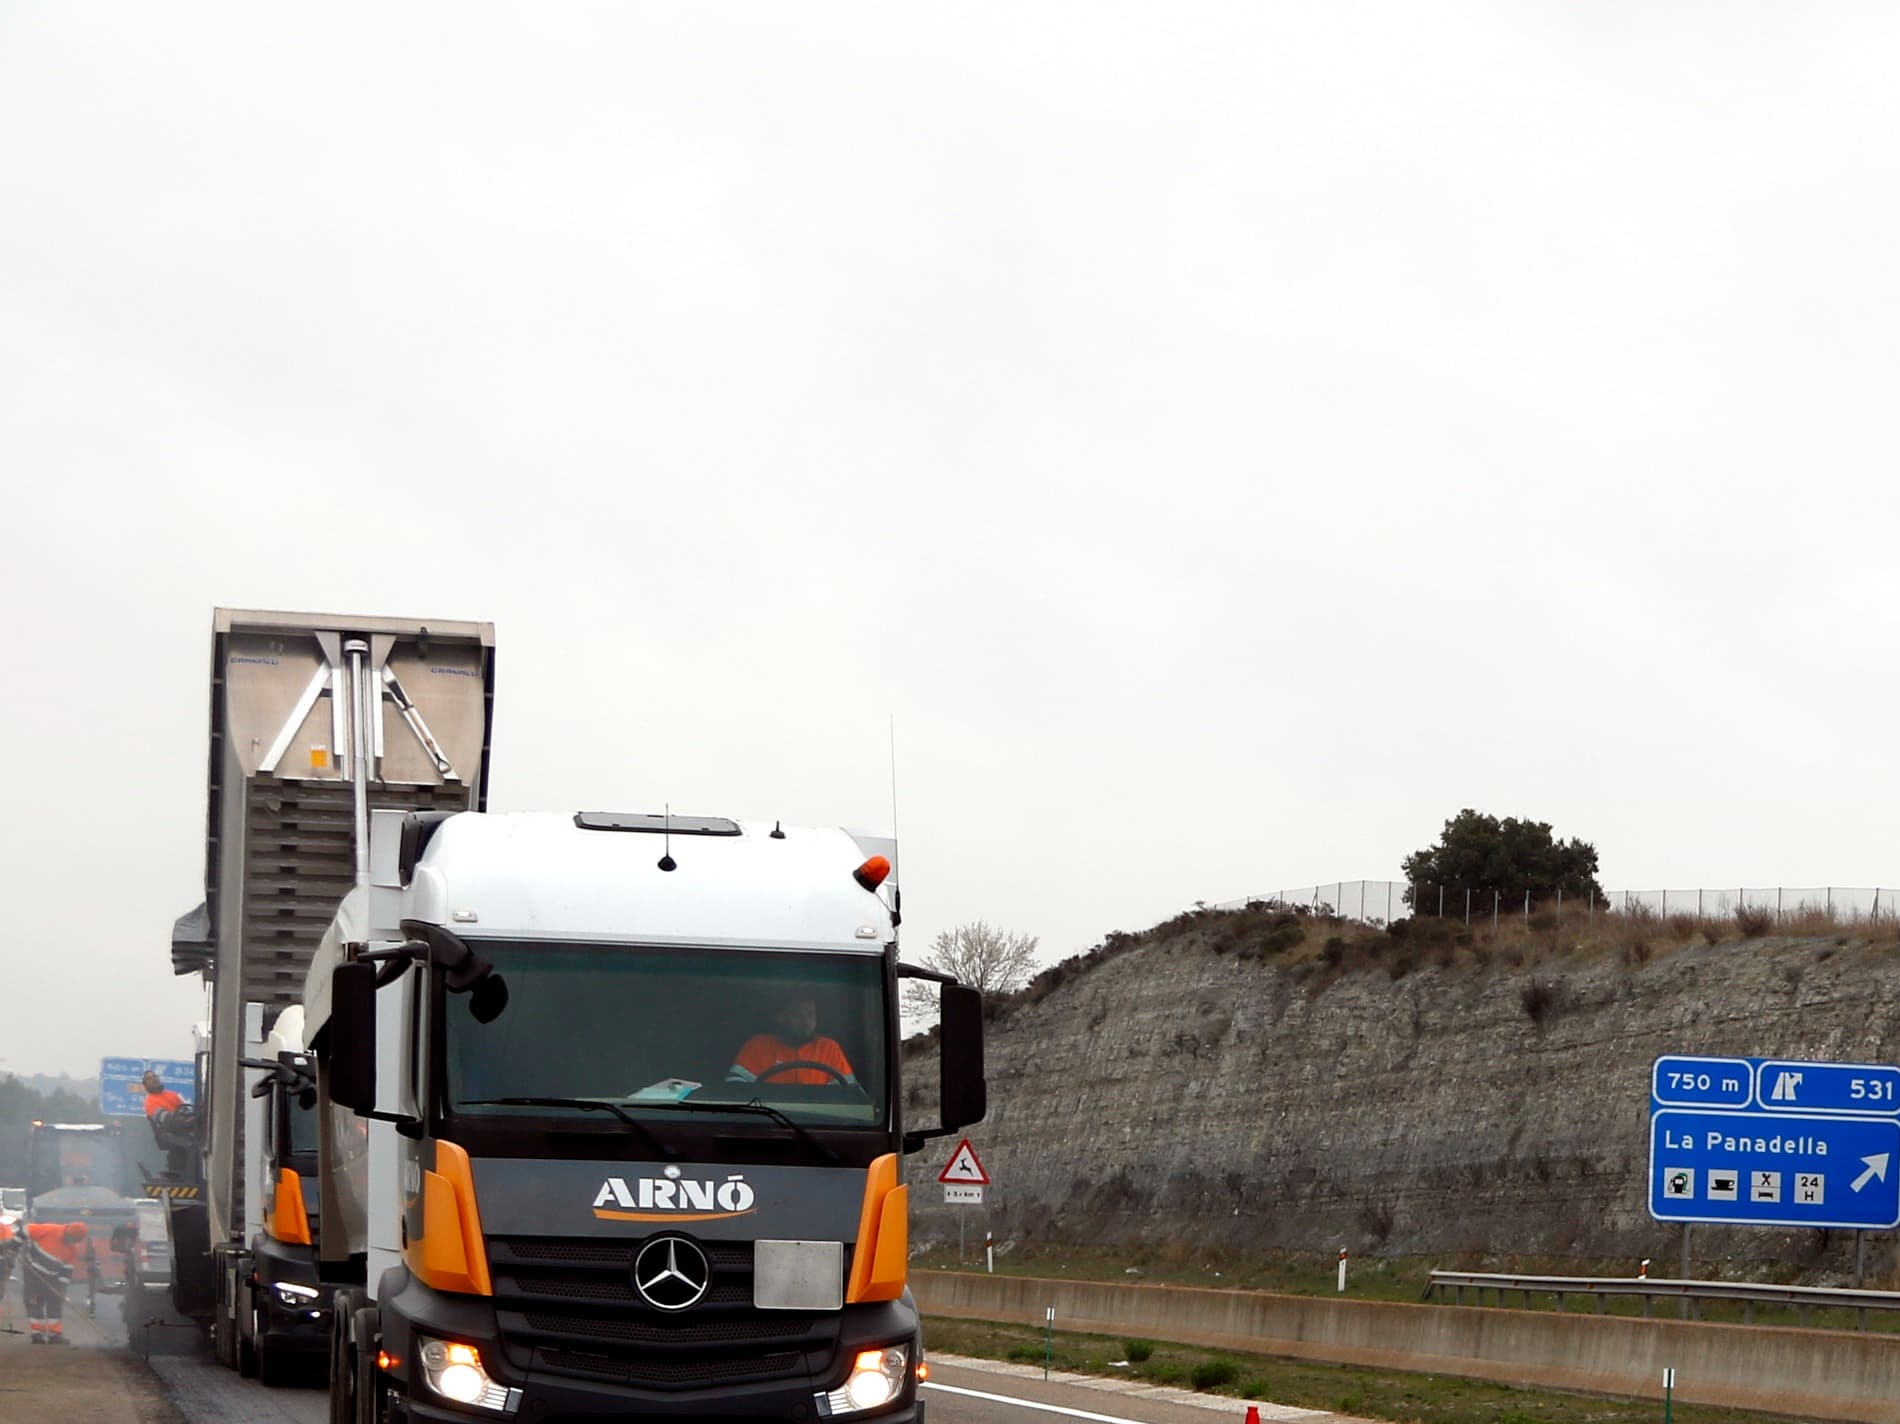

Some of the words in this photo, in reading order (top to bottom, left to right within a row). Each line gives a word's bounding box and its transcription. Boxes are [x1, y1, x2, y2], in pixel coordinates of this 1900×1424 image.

[1667, 1072, 1710, 1091] 750
[1722, 1079, 1739, 1092] m
[1850, 1079, 1893, 1100] 531
[1665, 1129, 1694, 1149] La
[1706, 1131, 1828, 1156] Panadella
[1800, 1175, 1819, 1188] 24
[592, 1174, 755, 1212] ARNÓ
[1804, 1190, 1814, 1201] H
